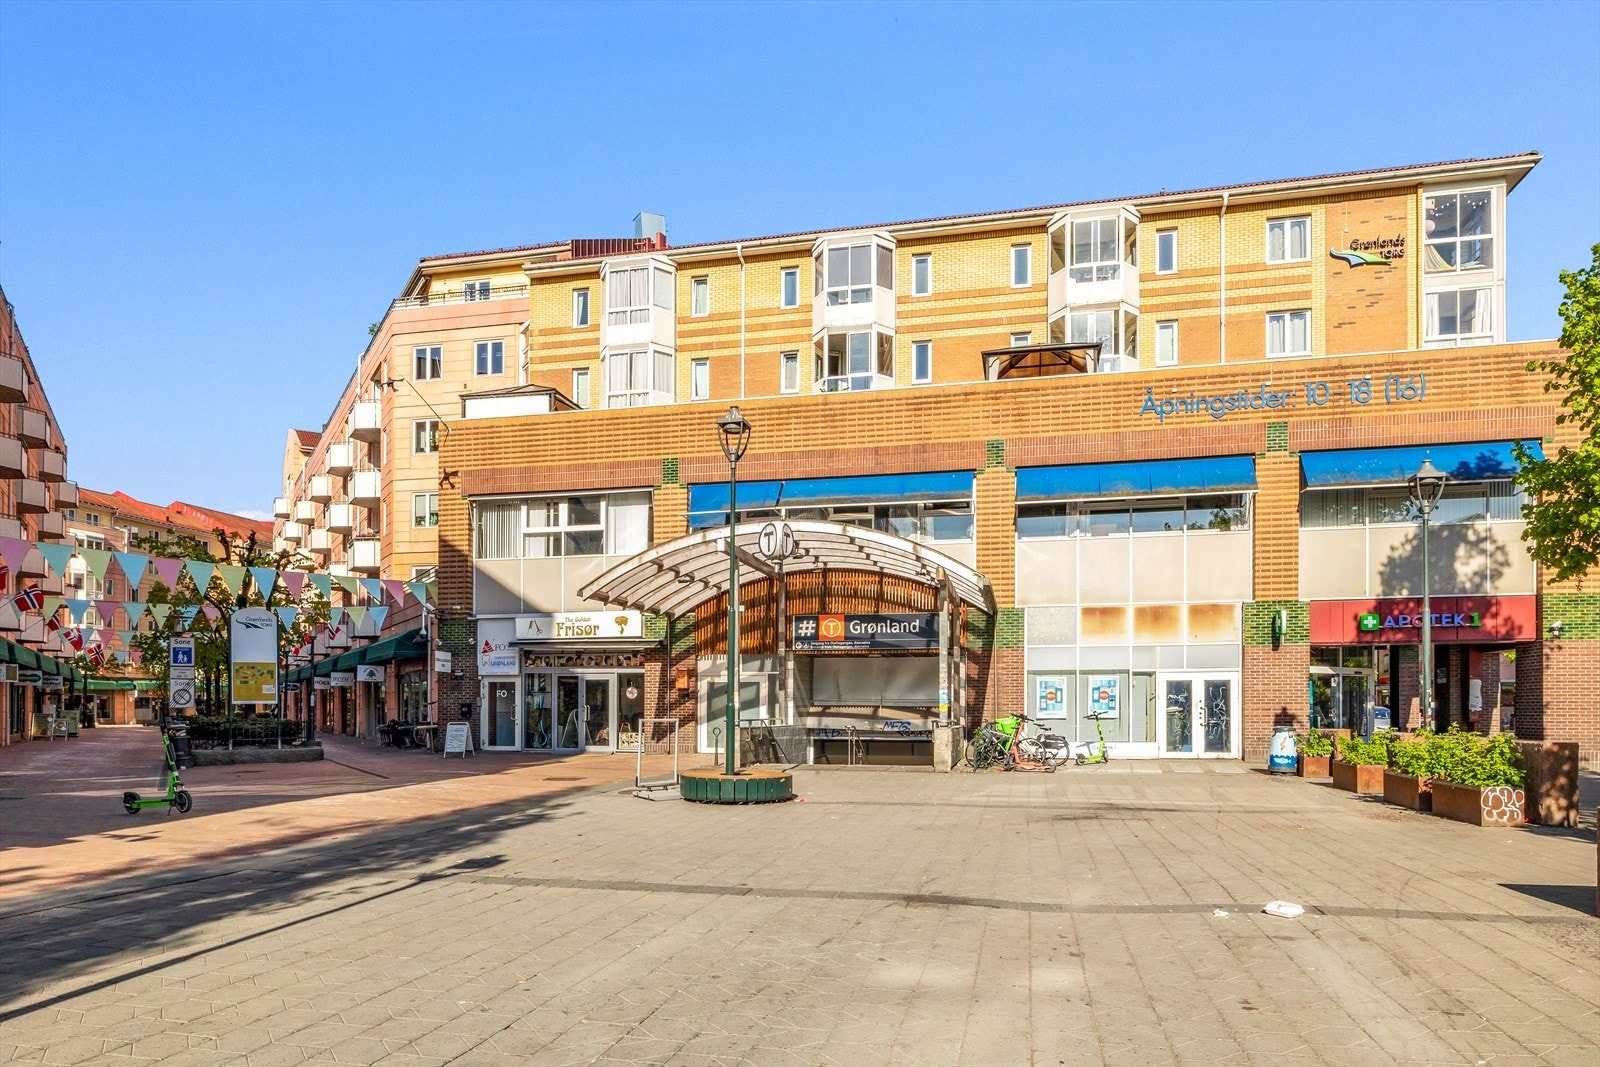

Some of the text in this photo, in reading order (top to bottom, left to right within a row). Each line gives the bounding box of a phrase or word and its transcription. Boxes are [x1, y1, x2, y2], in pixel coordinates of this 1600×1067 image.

[1139, 382, 1298, 422] Åpningstider:
[1304, 381, 1330, 406] 10
[1347, 378, 1373, 404] 18
[1385, 373, 1426, 405] (16)
[849, 619, 920, 634] Grønland
[1384, 612, 1482, 628] APOTEK 1
[556, 622, 600, 637] Frisør
